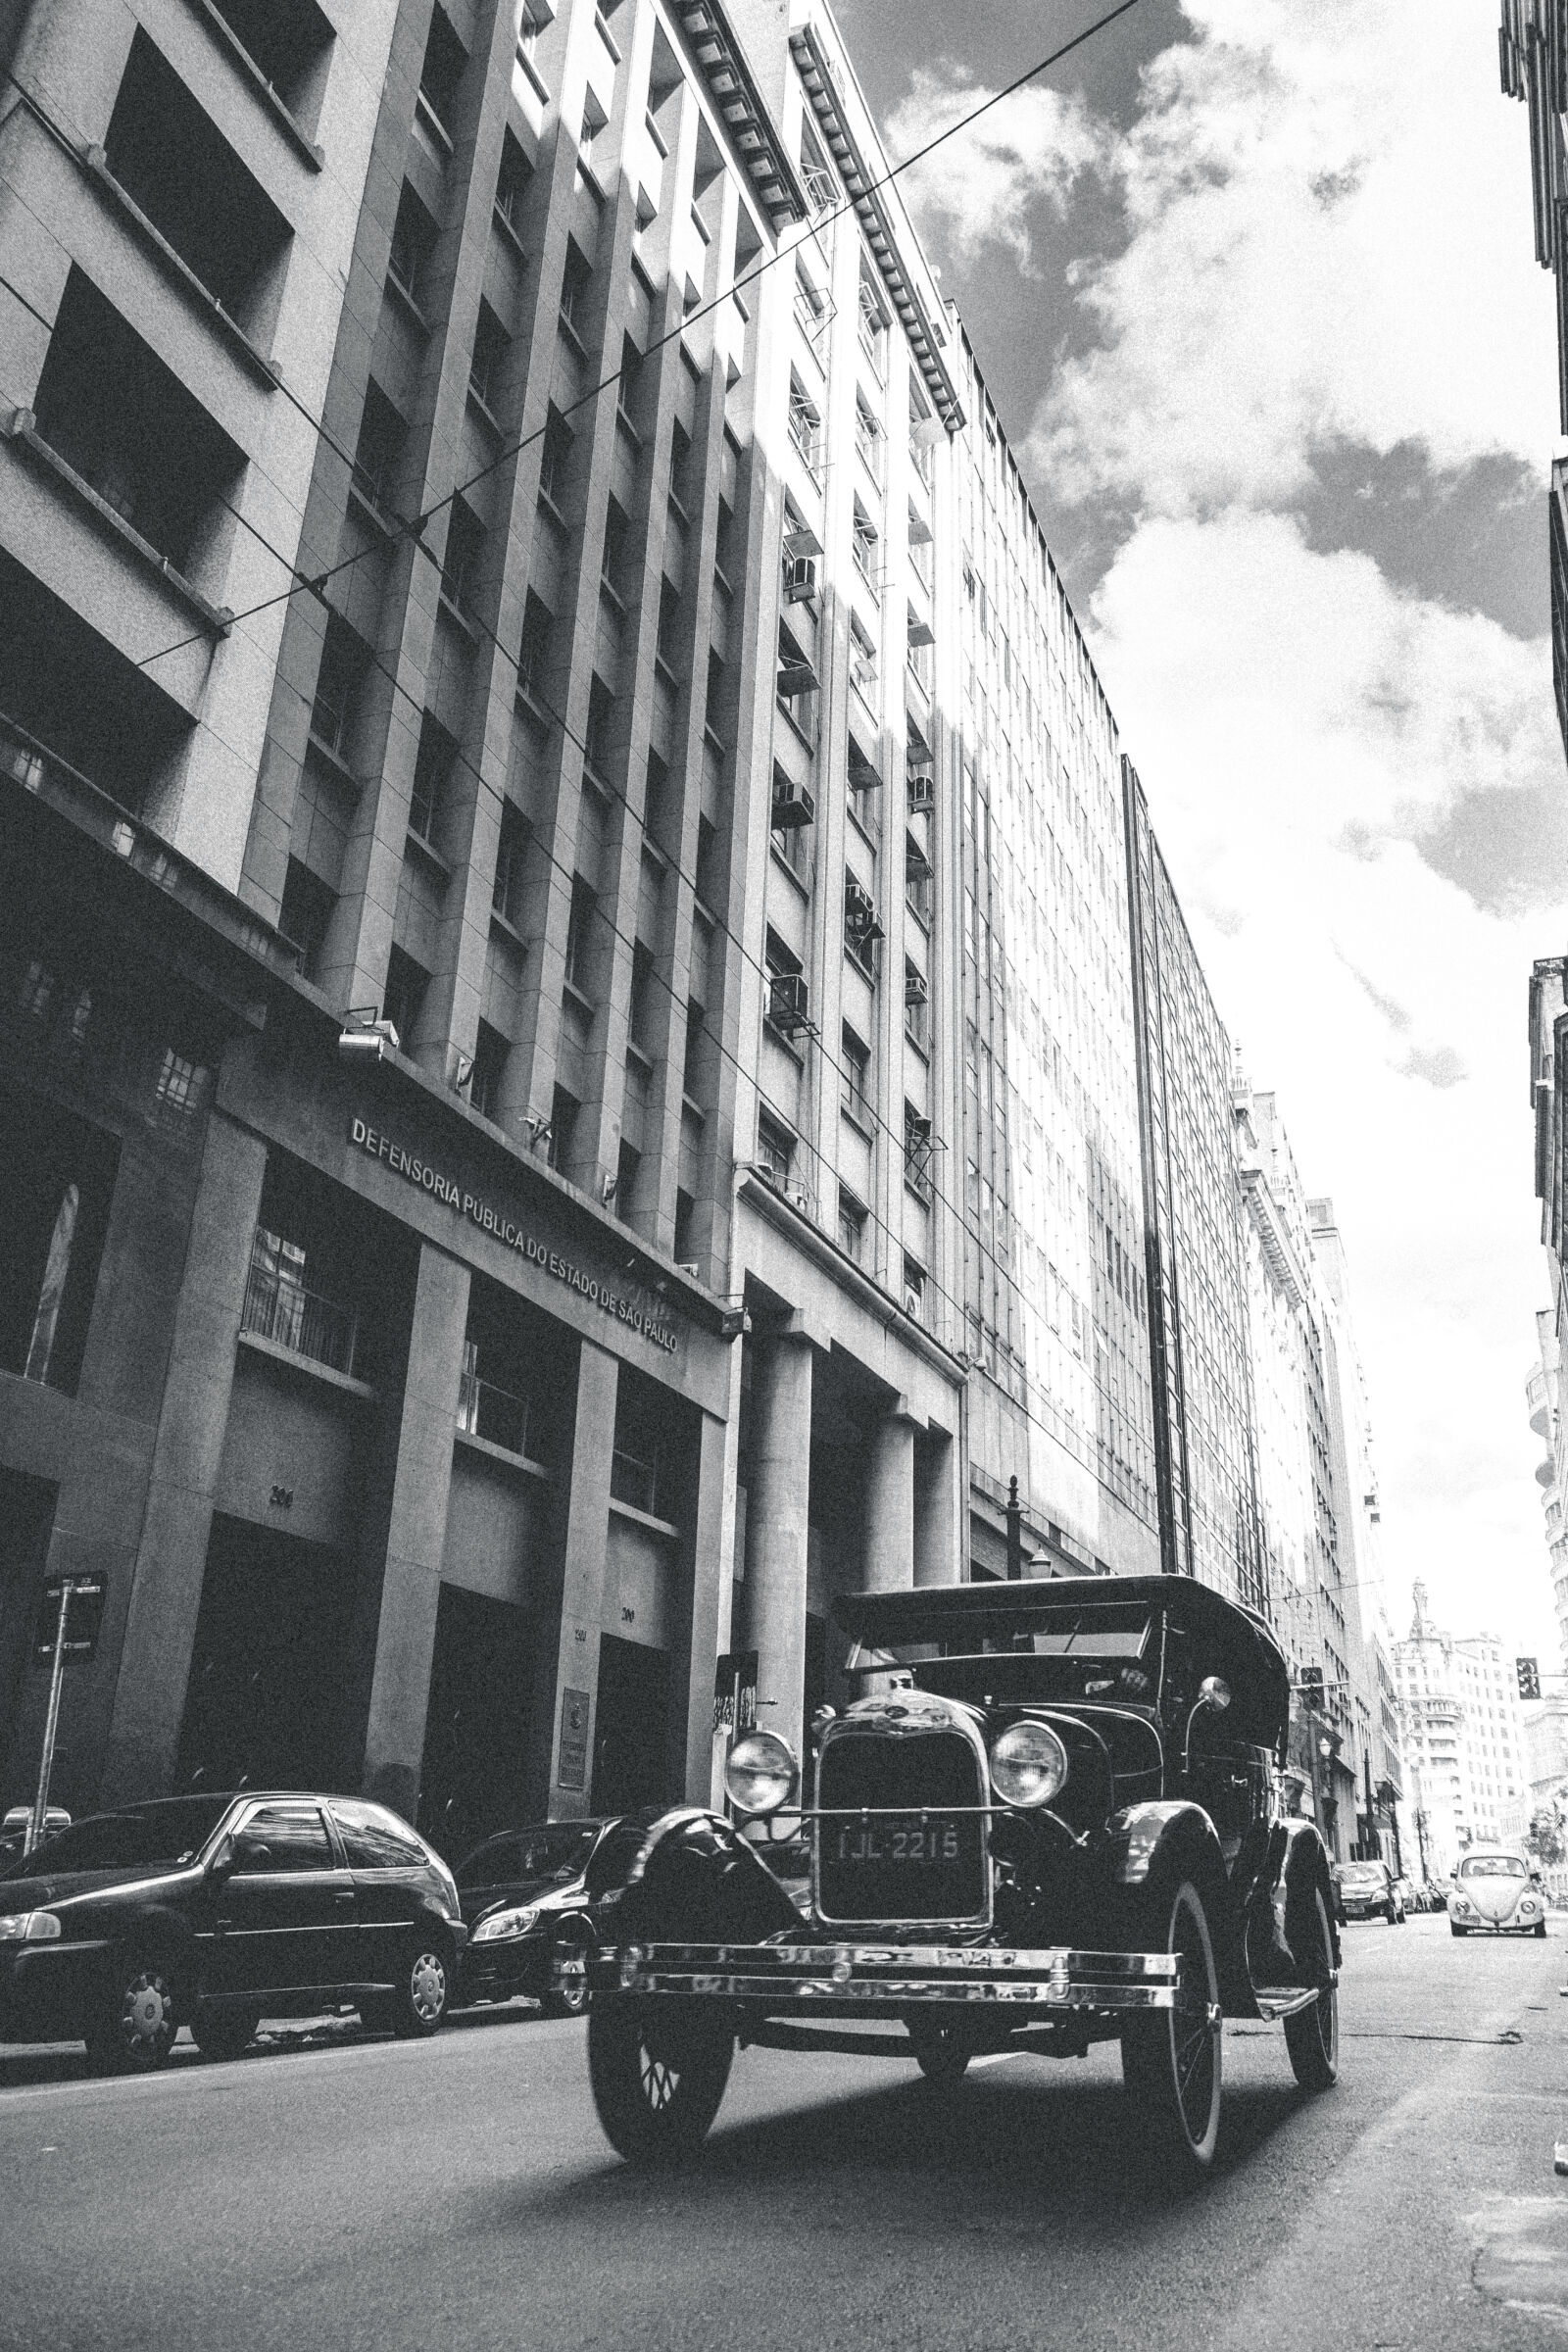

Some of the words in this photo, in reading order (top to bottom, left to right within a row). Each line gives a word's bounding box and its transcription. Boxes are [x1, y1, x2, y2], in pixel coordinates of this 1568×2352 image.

[353, 1118, 461, 1208] DEFENSORIA
[464, 1194, 524, 1251] PÚBLICA
[528, 1238, 547, 1264] DO
[550, 1254, 598, 1299] ESTADO
[601, 1289, 616, 1313] DE
[645, 1318, 678, 1352] PAULO
[893, 1832, 958, 1858] 2215
